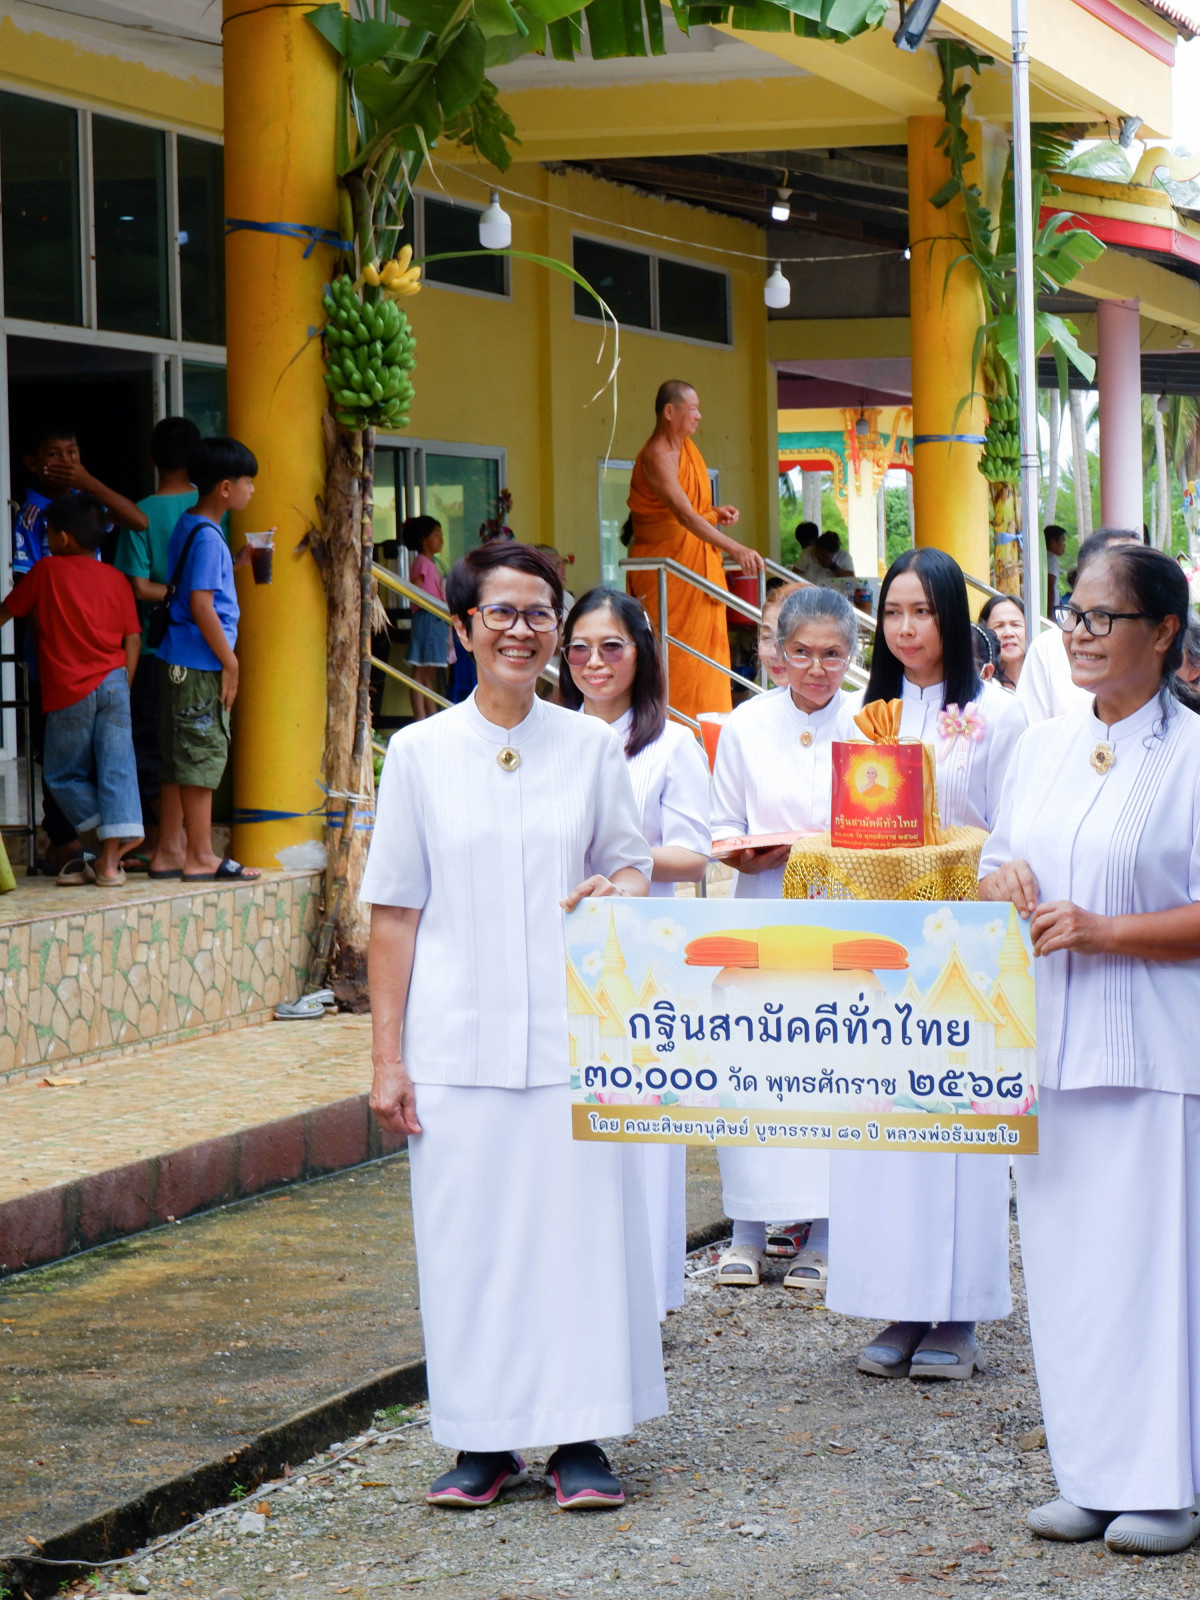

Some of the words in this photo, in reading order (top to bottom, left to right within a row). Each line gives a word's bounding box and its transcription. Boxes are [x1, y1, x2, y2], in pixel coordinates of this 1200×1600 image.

[628, 992, 970, 1053] กฐินสามัคคีทั่วไทย
[584, 1065, 718, 1094] ๓๐,๐๐๐
[728, 1066, 758, 1092] วัด
[765, 1069, 897, 1102] พุทธศักราช
[908, 1069, 1024, 1099] ๒๕๖๘
[590, 1115, 619, 1132] โดย
[625, 1117, 749, 1139] คณะศิษยานุศิษย์
[755, 1124, 831, 1142] บูชาธรรม
[838, 1127, 861, 1139] ๘๑
[867, 1123, 879, 1139] ปี
[886, 1125, 1018, 1144] หลวงพ่อธัมมชโย
